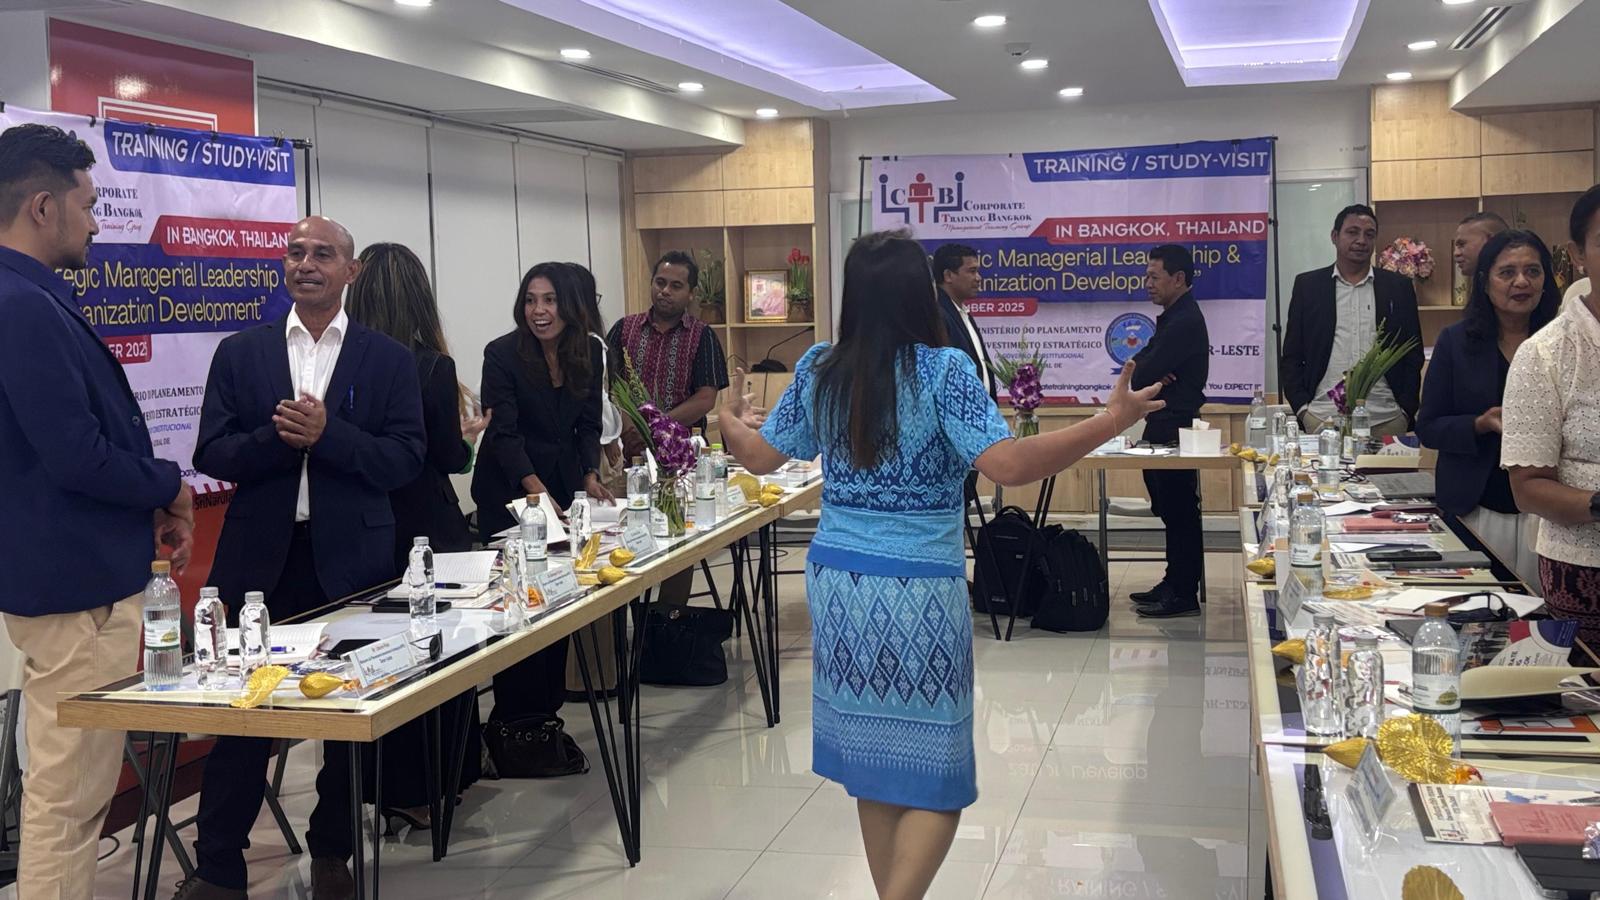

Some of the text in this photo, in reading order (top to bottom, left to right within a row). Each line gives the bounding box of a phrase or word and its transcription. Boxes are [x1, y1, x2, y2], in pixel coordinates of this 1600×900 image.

[112, 131, 291, 173] TRAINING / STUDY-VISIT
[1033, 151, 1268, 174] TRAINING / STUDY-VISIT
[95, 186, 139, 200] RPORATE
[963, 199, 1026, 212] CORPORATE
[167, 225, 290, 249] IN BANGKOK, THAILAN
[1055, 219, 1265, 239] IN BANGKOK, THAILAND
[998, 247, 1107, 271] Managerial
[1226, 244, 1241, 264] &
[200, 262, 279, 293] Leadership
[977, 273, 1056, 292] anization
[83, 297, 155, 326] anization
[998, 302, 1026, 313] 2025
[980, 325, 1021, 335] NISTÉRIO
[1038, 325, 1103, 334] PLANEAMENTO
[1042, 338, 1103, 349] ESTRATÉGICO
[155, 405, 201, 419] ESTRATÉGIC
